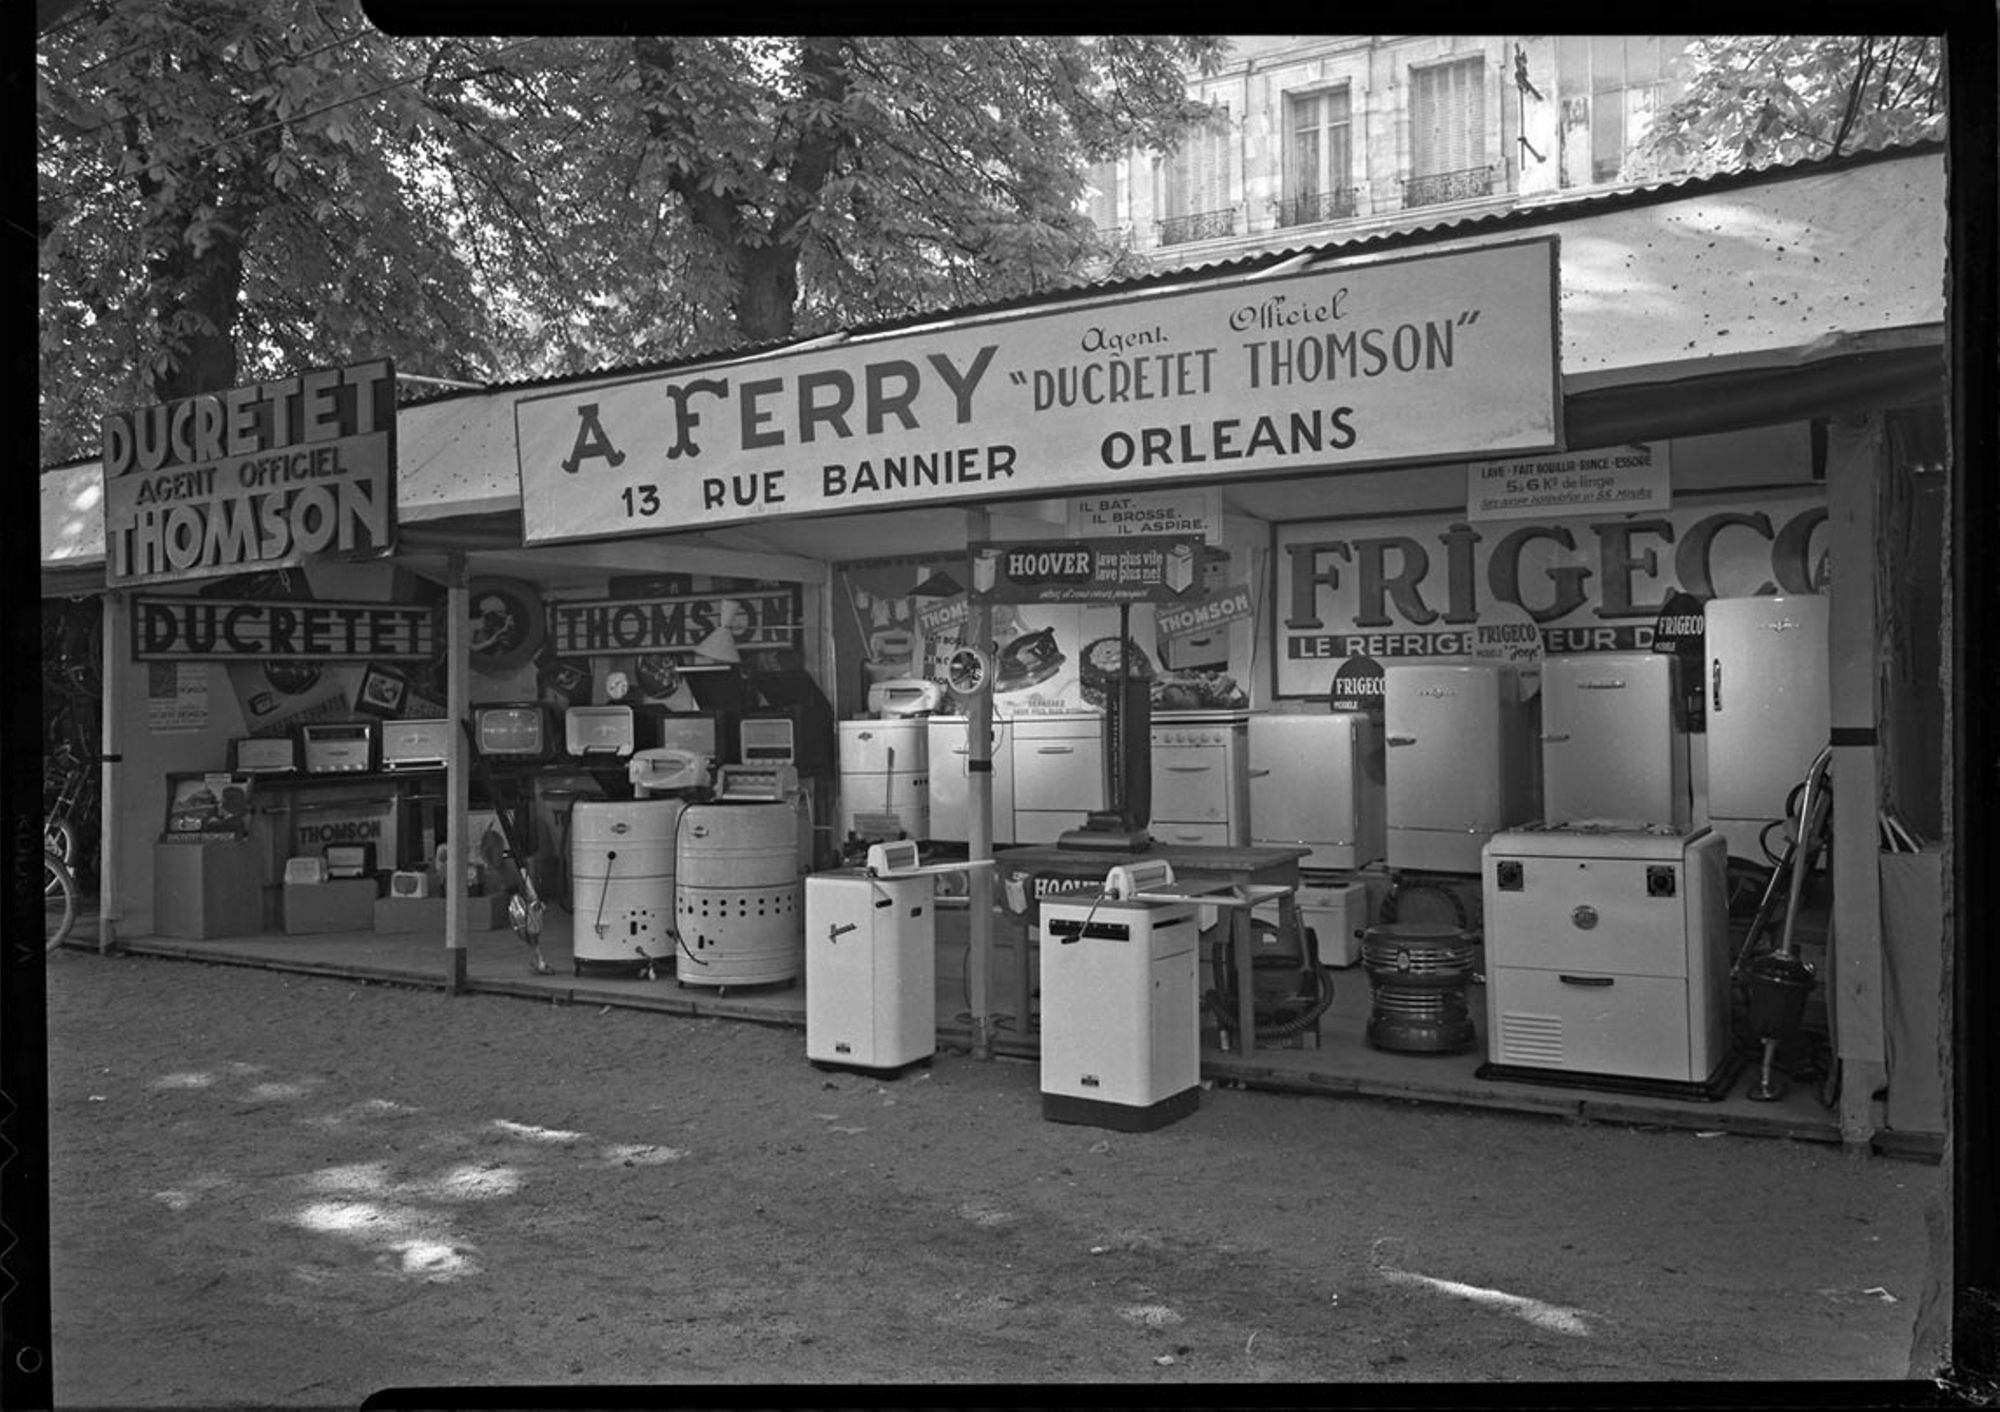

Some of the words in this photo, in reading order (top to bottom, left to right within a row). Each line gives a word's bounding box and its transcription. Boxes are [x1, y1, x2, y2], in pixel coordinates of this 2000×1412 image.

[1229, 288, 1349, 332] Officiel
[103, 358, 391, 479] DUCRETET
[561, 403, 626, 473] A
[666, 344, 998, 459] FERRY
[621, 485, 661, 518] 13
[704, 470, 785, 509] RUE
[822, 444, 1017, 497] BANNIER
[1101, 406, 1357, 469] ORLEANS
[137, 468, 217, 507] AGENT
[239, 446, 348, 488] OFFICIEL
[1080, 502, 1092, 512] IL
[1092, 514, 1107, 524] IL
[1112, 508, 1182, 523] BROSSE.
[109, 478, 390, 577] THOMSON
[1118, 524, 1132, 534] IL
[1140, 518, 1208, 533] ASPIRE.
[1009, 552, 1090, 576] HOOVER
[1119, 550, 1141, 568] plus
[1119, 566, 1141, 584] plus
[561, 598, 790, 650] THOMSON
[1158, 593, 1249, 634] THOMSON
[1658, 615, 1703, 636] FRIGECO
[145, 603, 426, 654] DUCRETET
[1477, 624, 1537, 644] FRIGECO
[1300, 637, 1331, 657] LE
[1336, 677, 1387, 695] FRIGECO
[298, 820, 382, 844] THOMSON
